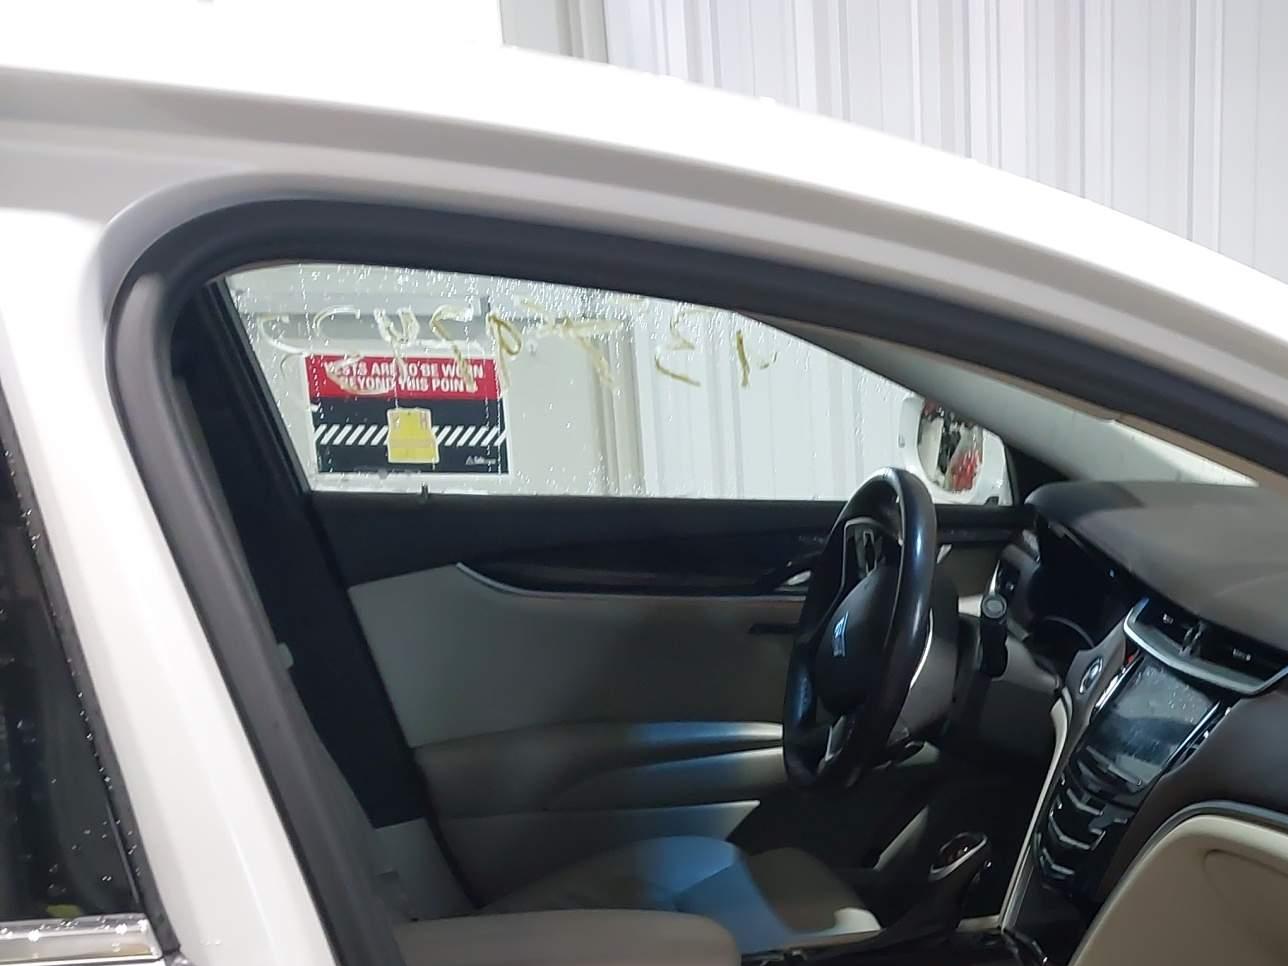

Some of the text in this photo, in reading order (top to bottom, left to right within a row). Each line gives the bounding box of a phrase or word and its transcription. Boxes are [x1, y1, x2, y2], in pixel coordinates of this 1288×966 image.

[371, 362, 395, 377] ARE
[420, 363, 439, 377] BE
[341, 376, 395, 392] EYOND
